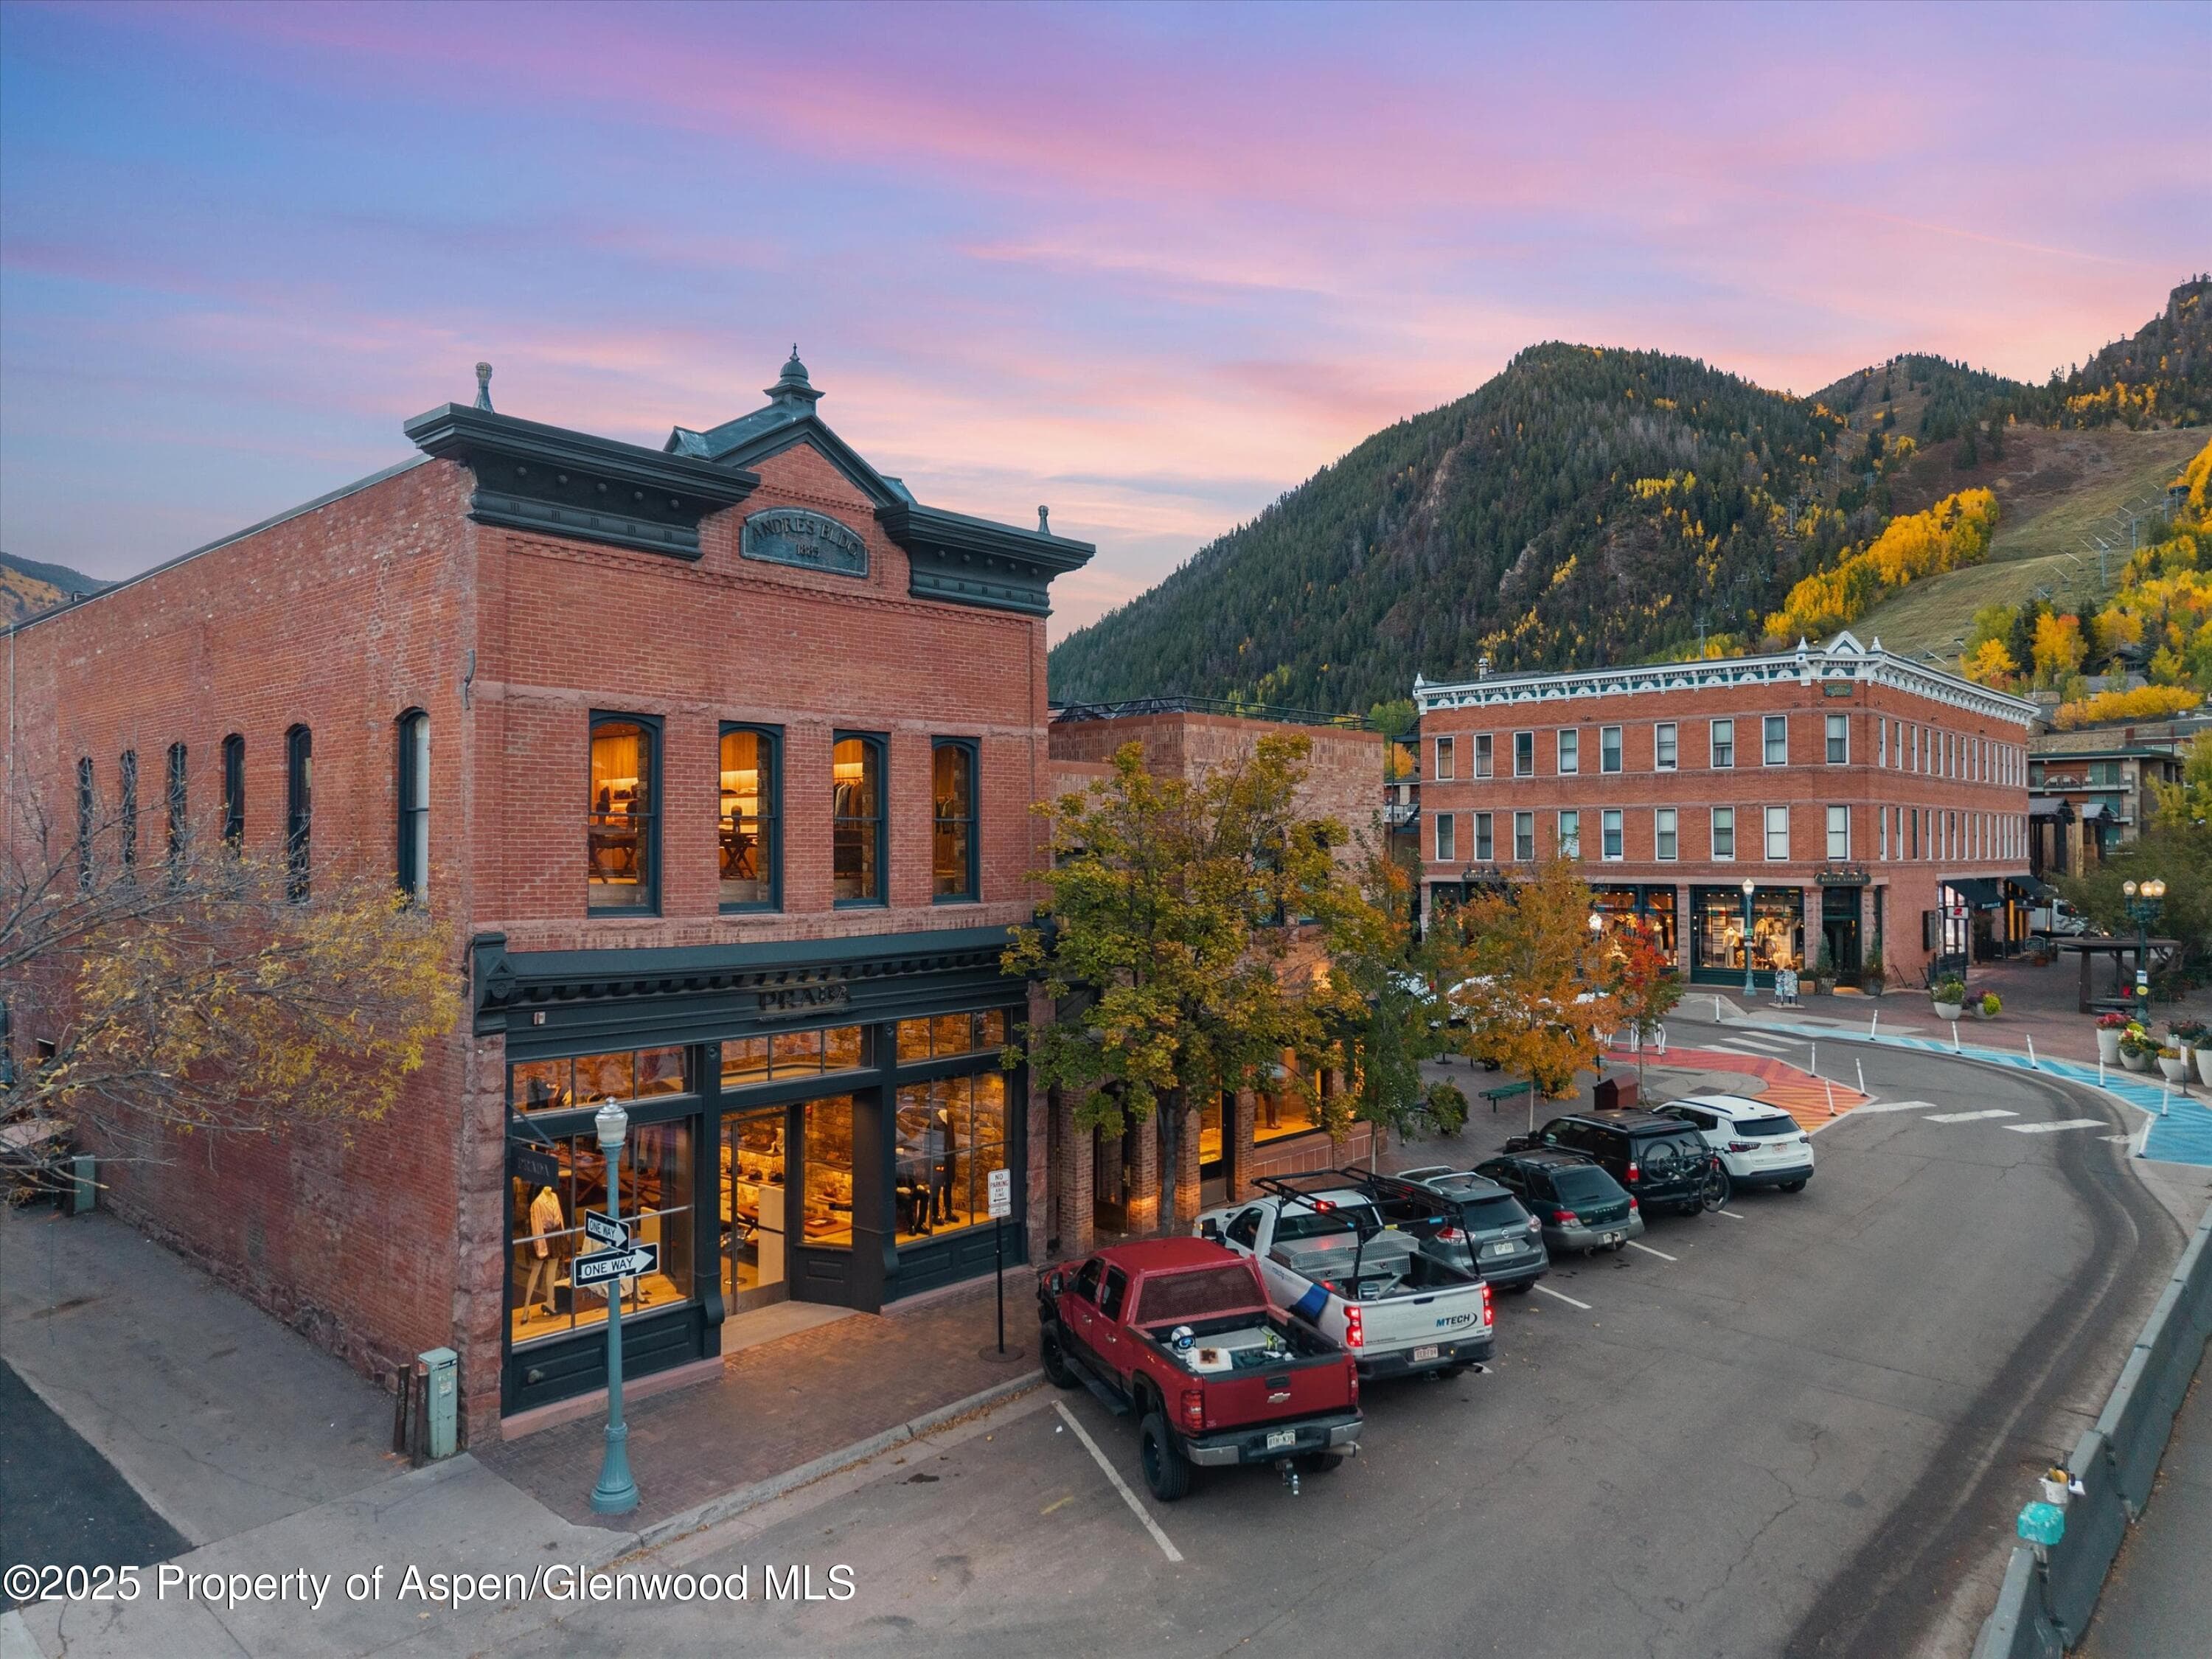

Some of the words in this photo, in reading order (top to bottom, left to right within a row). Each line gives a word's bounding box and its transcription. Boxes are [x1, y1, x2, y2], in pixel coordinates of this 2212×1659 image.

[589, 1220, 601, 1234] ONE
[602, 1225, 616, 1239] WAY
[584, 1262, 608, 1276] ONE
[611, 1256, 634, 1271] WAY
[1436, 1314, 1470, 1327] MTECH
